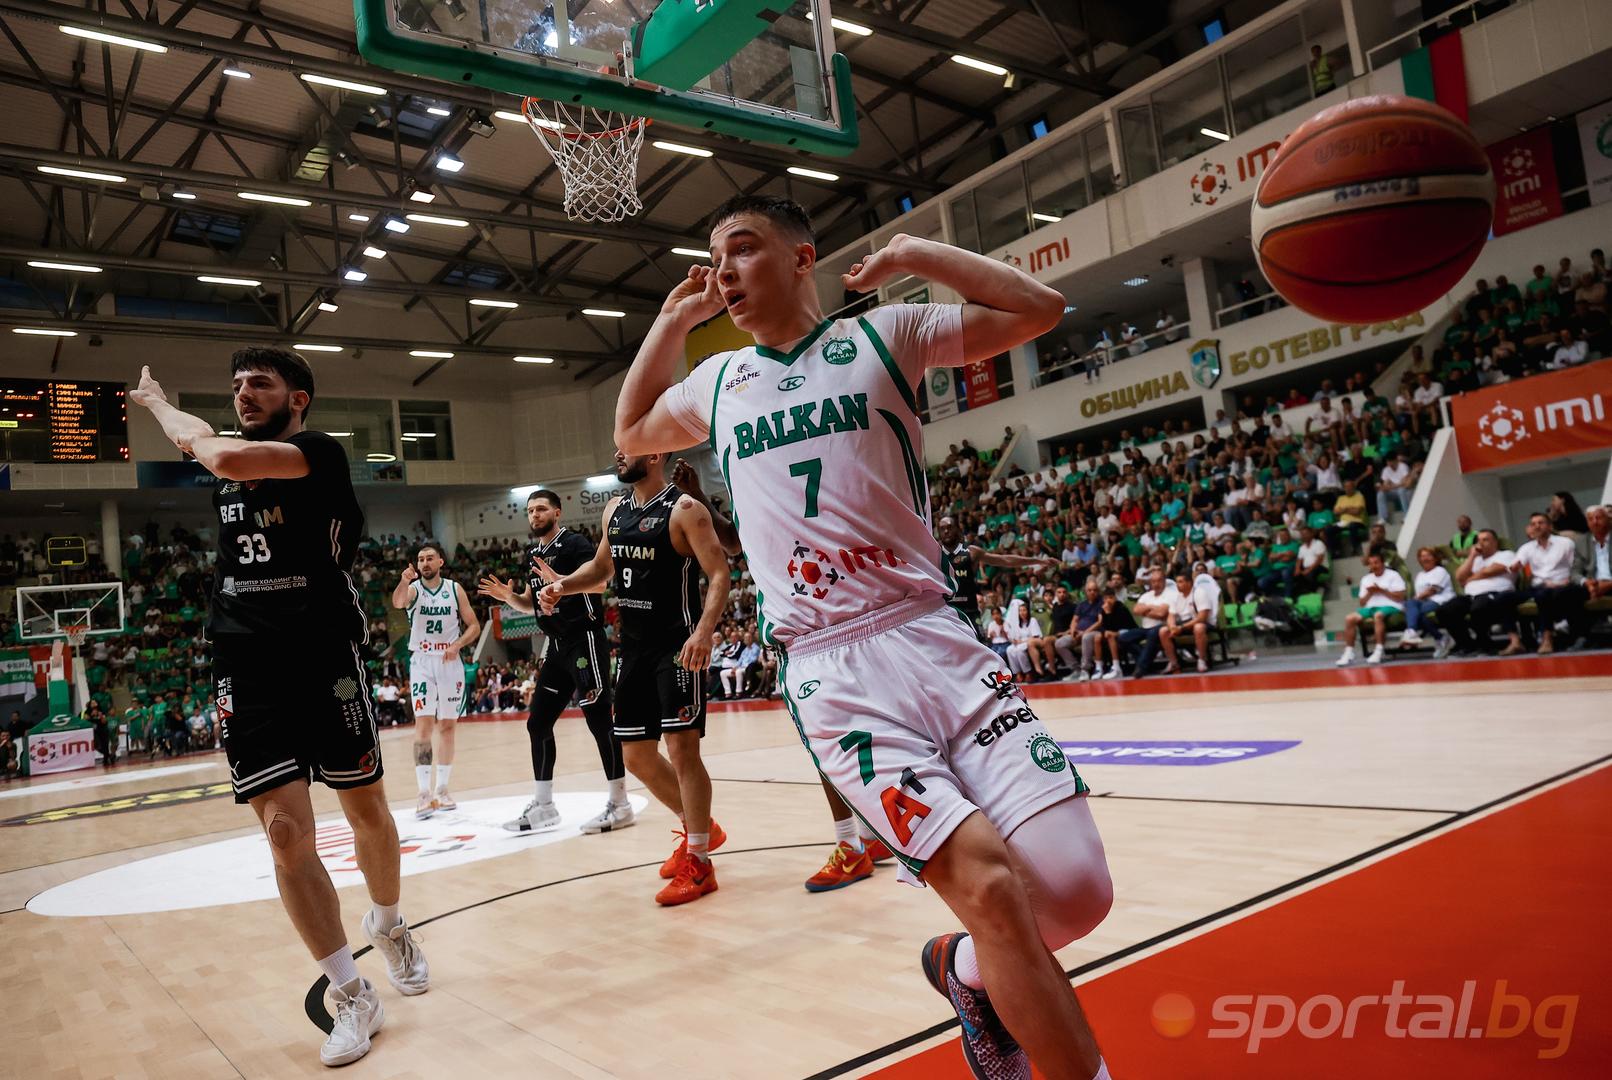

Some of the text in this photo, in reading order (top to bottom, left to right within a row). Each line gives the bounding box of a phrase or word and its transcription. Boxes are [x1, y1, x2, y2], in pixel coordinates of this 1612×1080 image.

[725, 370, 761, 391] SESAME
[1080, 371, 1189, 418] ОБЩИНА
[734, 392, 870, 460] BALKAN
[789, 457, 822, 518] 7
[236, 533, 271, 565] 33
[609, 545, 655, 560] ETVAM
[622, 567, 632, 589] 9
[420, 605, 451, 616] BALKAN
[425, 619, 443, 634] 24
[412, 681, 428, 697] 24
[839, 730, 876, 787] 7
